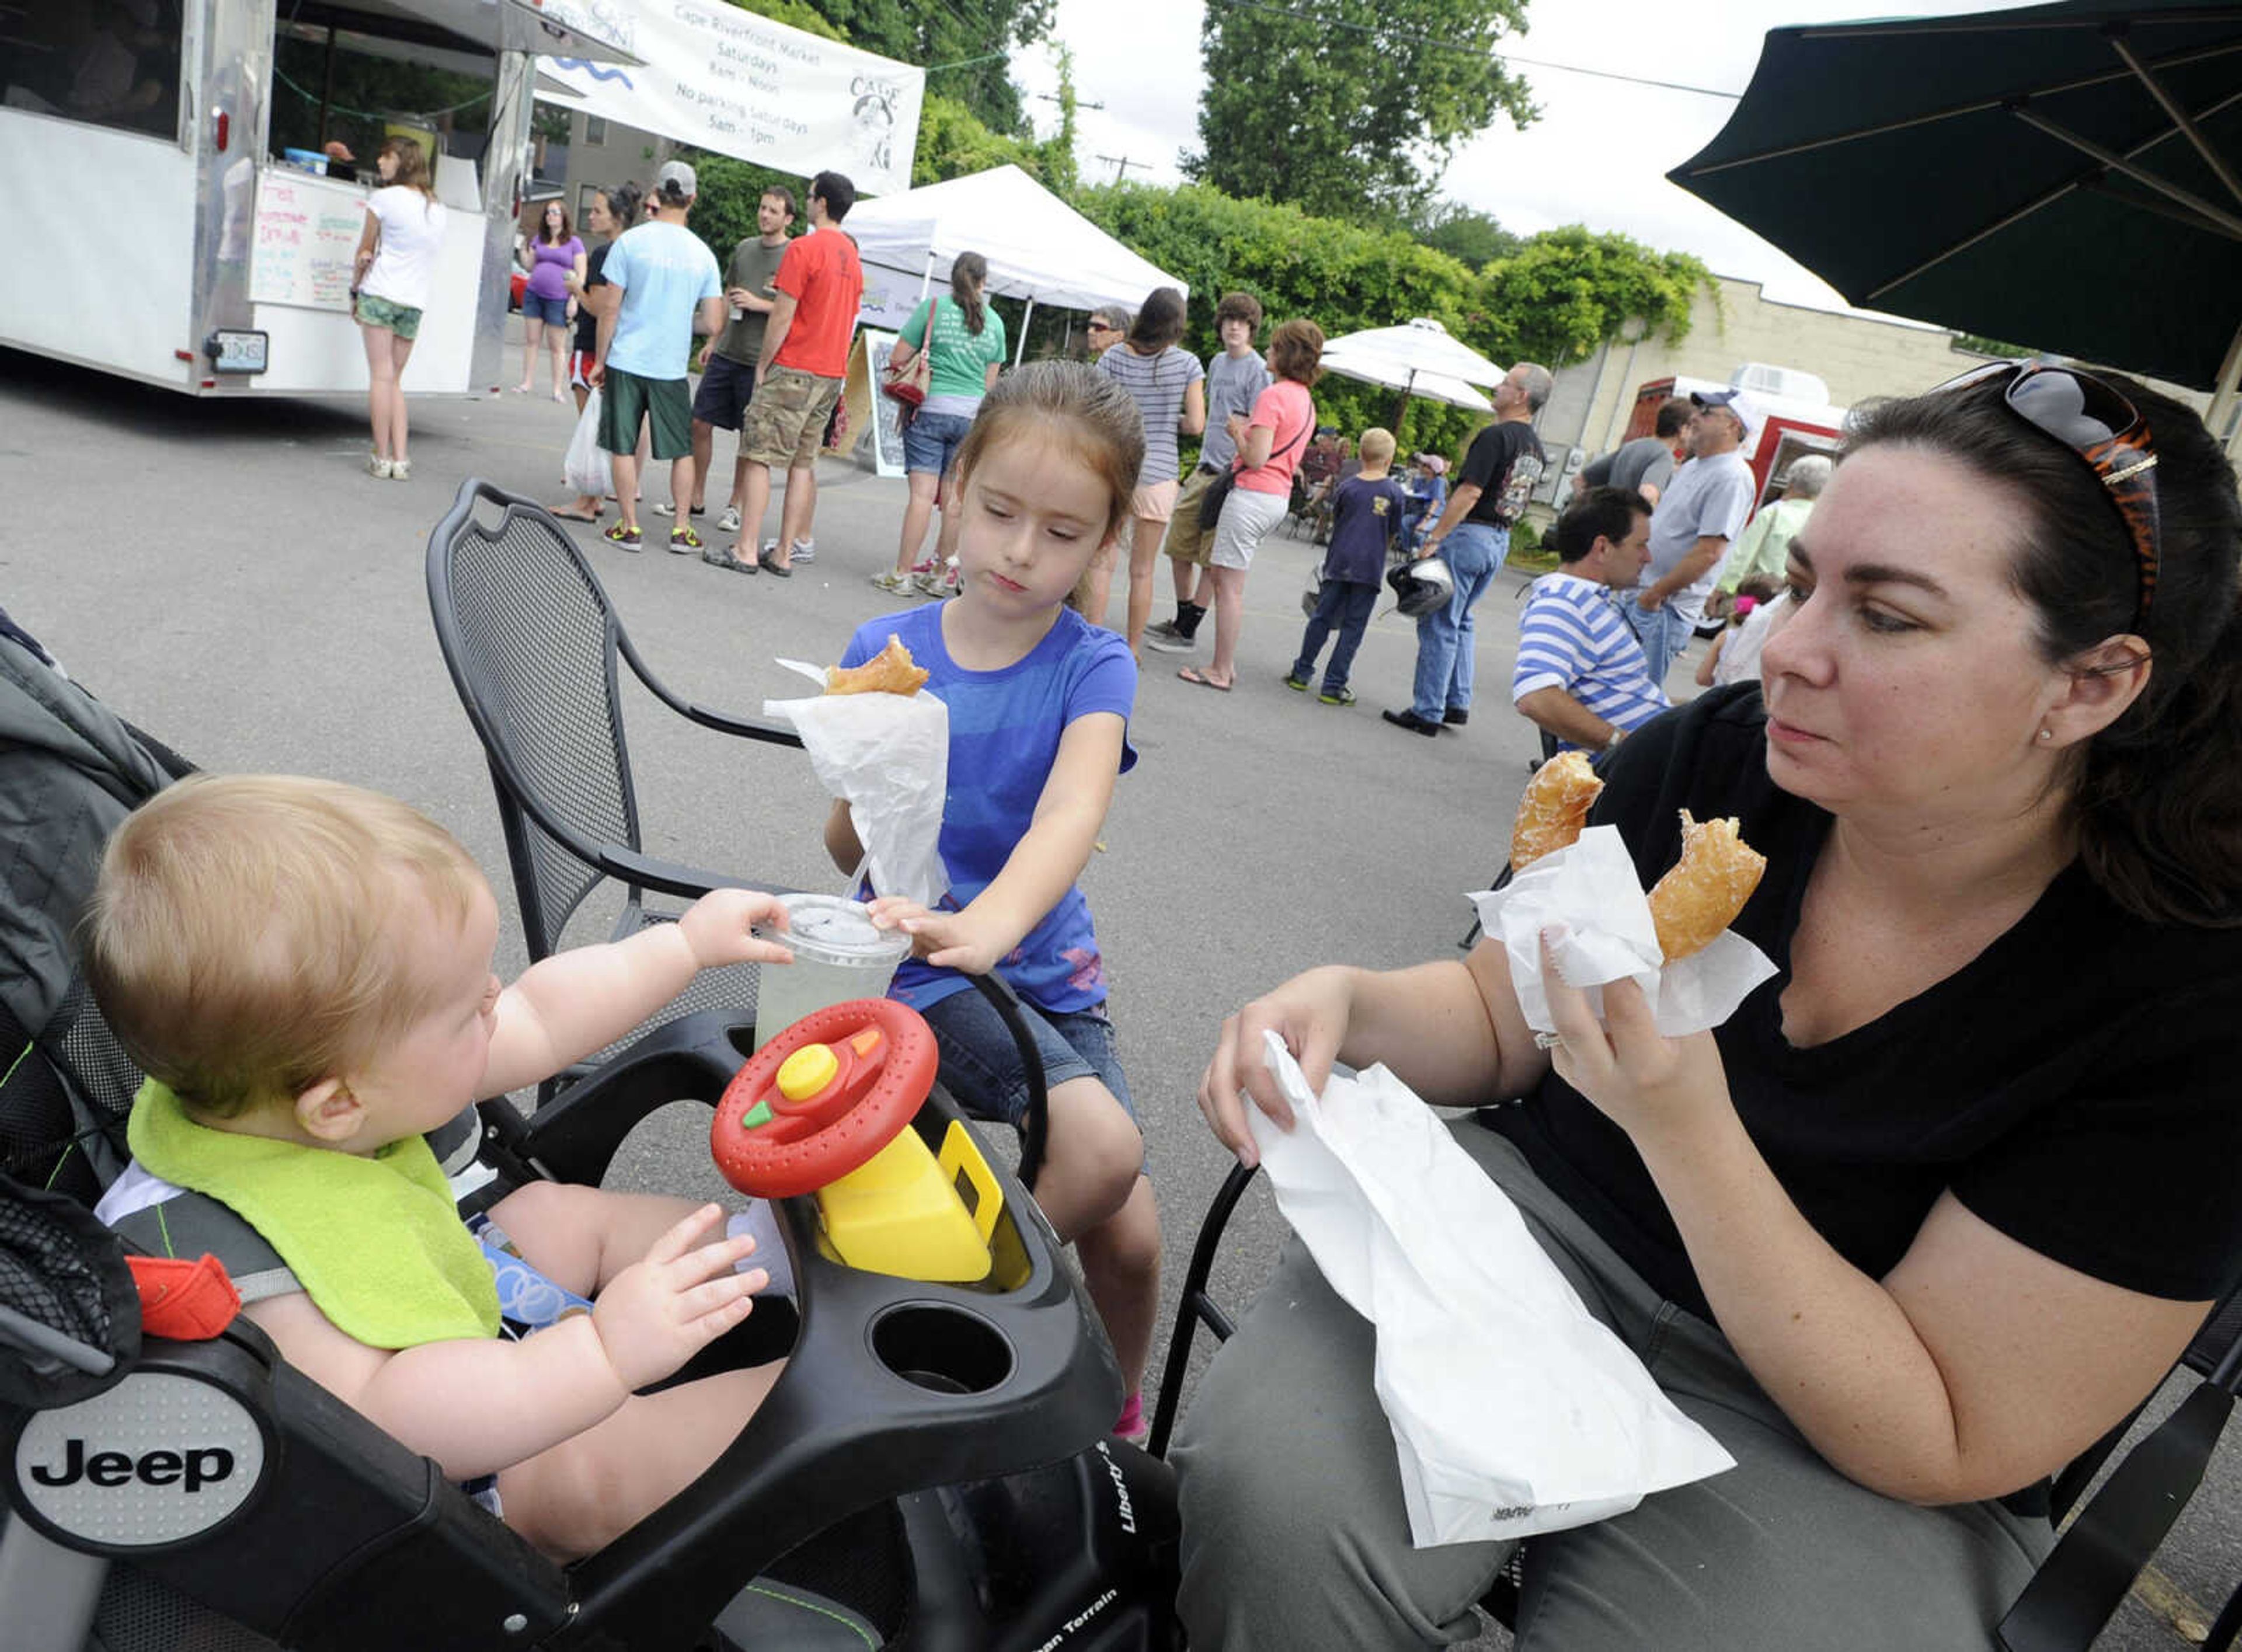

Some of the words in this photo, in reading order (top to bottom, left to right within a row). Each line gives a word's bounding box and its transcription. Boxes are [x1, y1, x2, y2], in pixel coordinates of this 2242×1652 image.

[717, 41, 778, 75] Saturdays
[675, 82, 695, 99] No
[708, 114, 736, 133] 5am
[750, 124, 775, 145] 1pm
[31, 1439, 234, 1493] Jeep
[1062, 1589, 1117, 1633] Terrain
